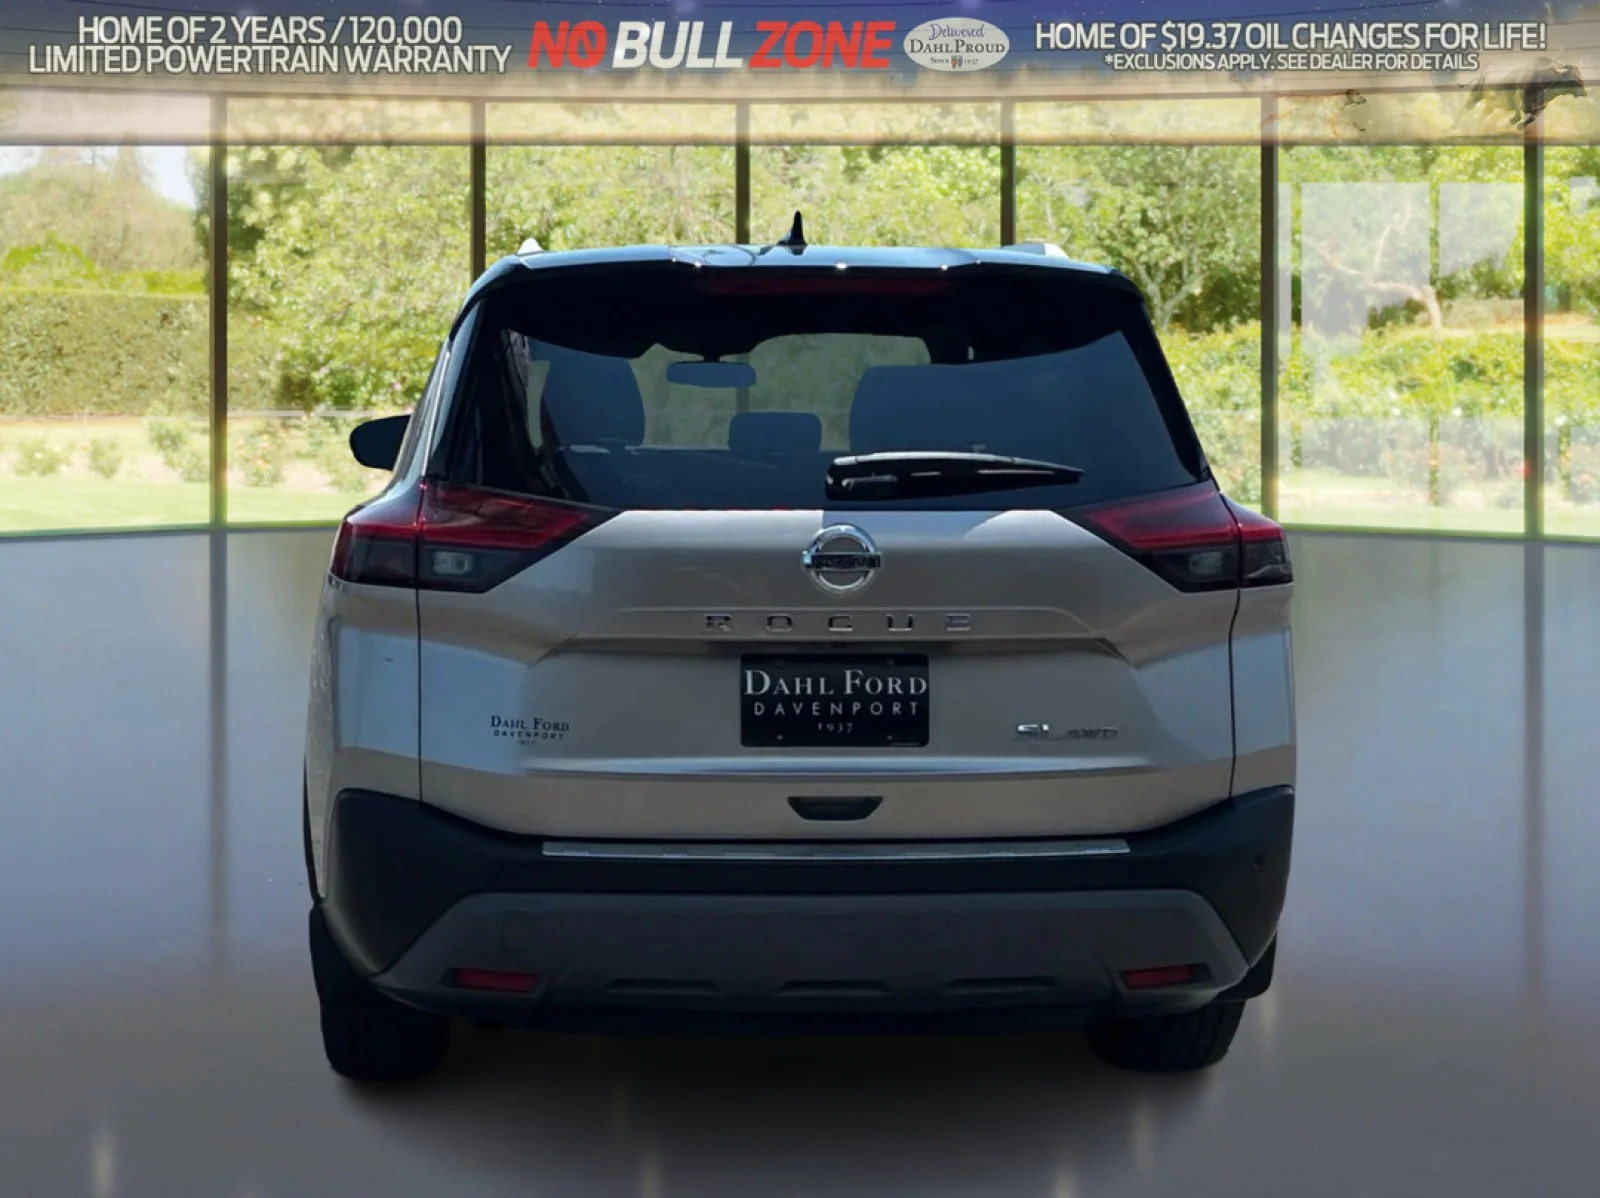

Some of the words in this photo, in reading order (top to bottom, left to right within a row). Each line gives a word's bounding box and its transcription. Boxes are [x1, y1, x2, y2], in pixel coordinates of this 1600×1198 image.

[704, 613, 971, 632] ROGUE
[744, 669, 834, 696] DAHL
[843, 669, 927, 696] FORD
[754, 701, 919, 716] DAVENPORT
[493, 729, 564, 740] DAVENPORT
[817, 722, 853, 733] 1937
